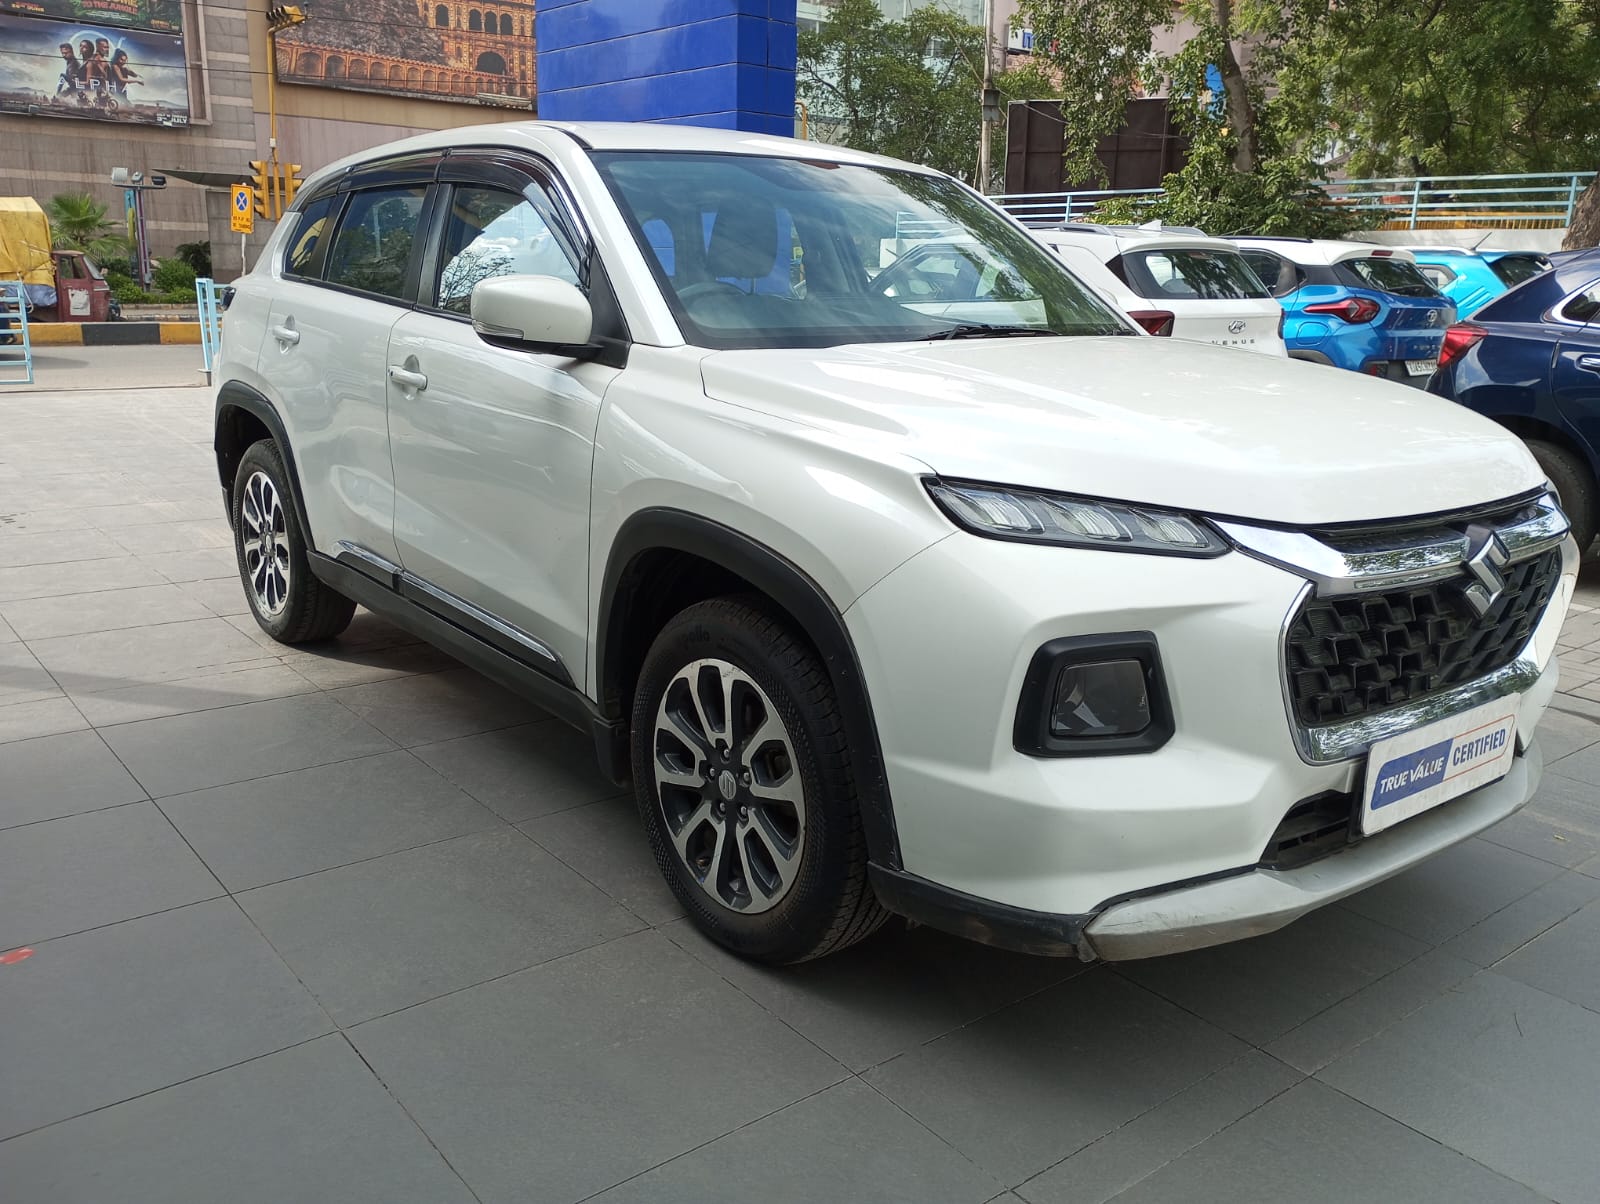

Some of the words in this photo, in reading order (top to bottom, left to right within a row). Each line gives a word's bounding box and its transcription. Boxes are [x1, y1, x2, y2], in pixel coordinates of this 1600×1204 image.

[57, 76, 129, 98] ALPHA
[1380, 771, 1408, 795] TRUE
[1410, 757, 1444, 783] VALUE
[1452, 728, 1506, 766] CERTIFIED
